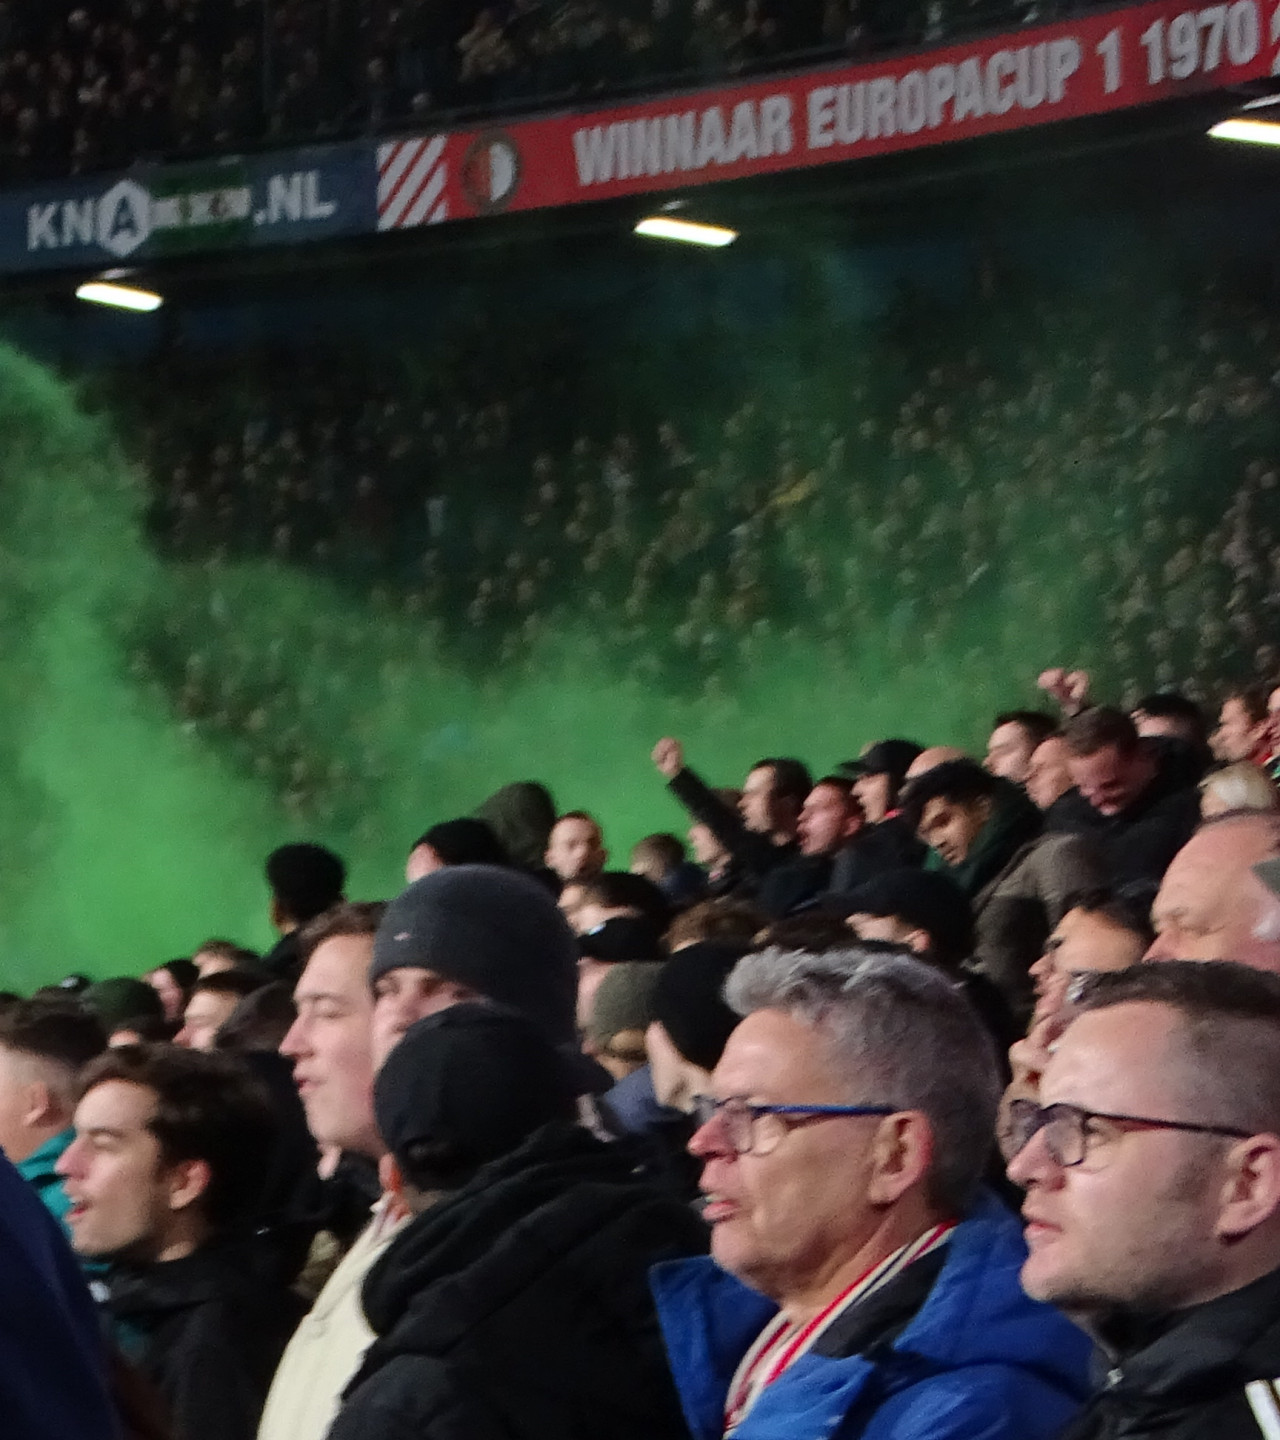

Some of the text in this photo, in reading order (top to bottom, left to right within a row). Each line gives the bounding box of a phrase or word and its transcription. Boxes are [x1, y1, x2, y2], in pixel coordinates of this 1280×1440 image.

[572, 94, 794, 187] WINNAAR
[807, 36, 1083, 150] EUROPACUP
[1096, 27, 1123, 95] 1
